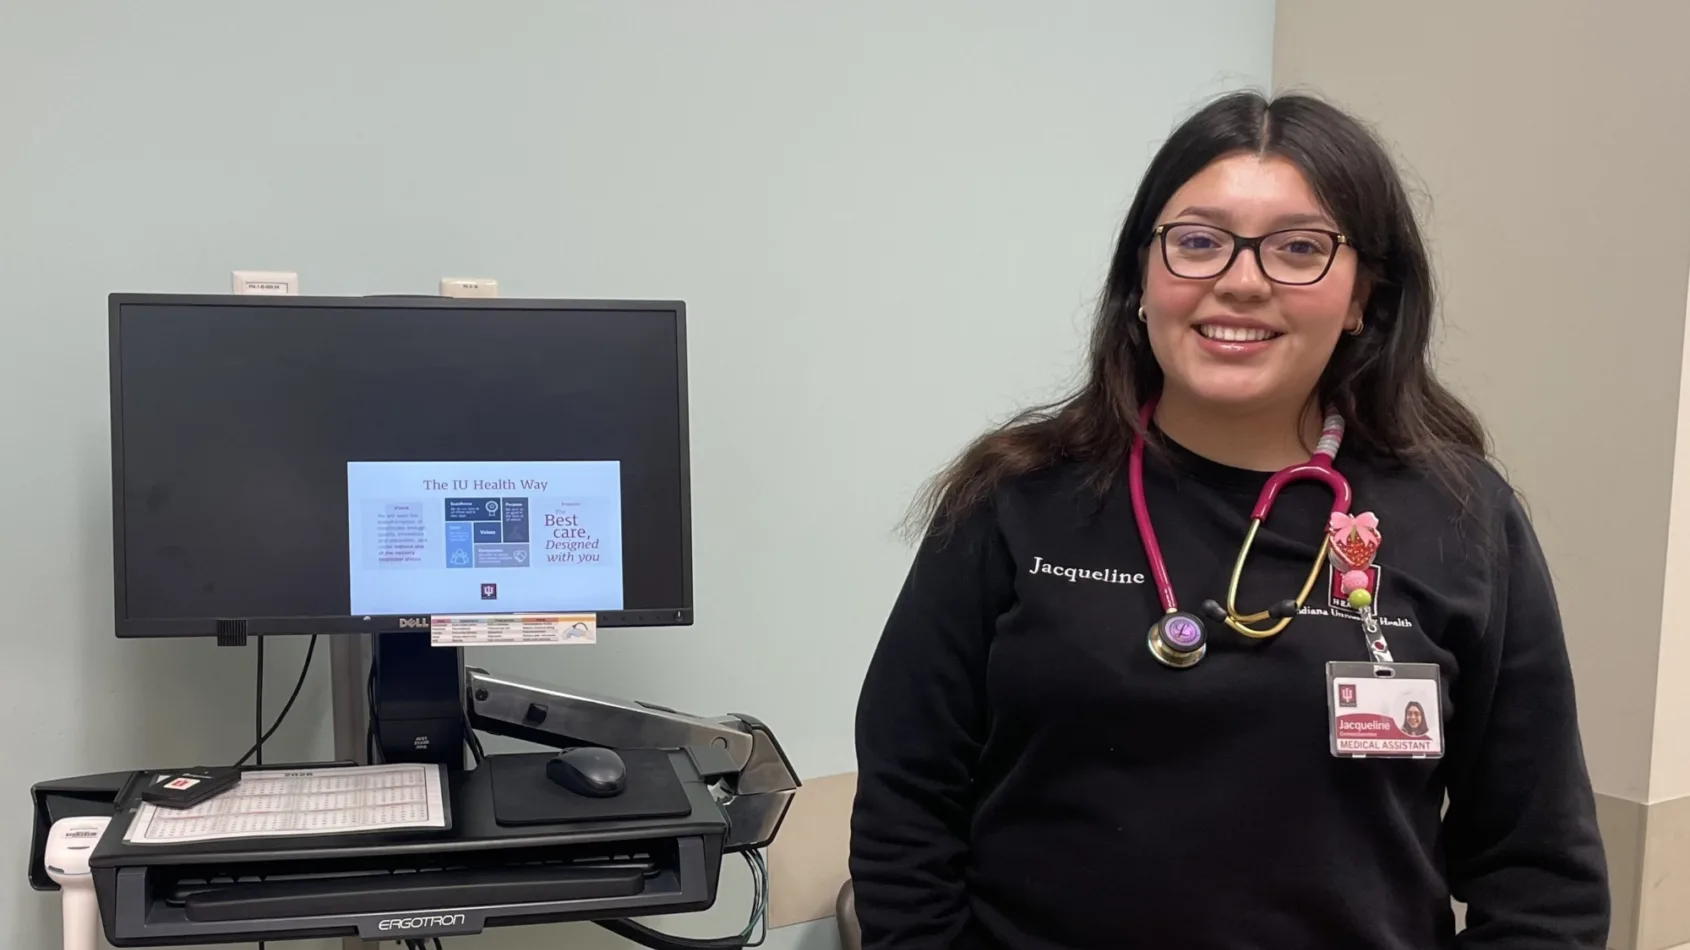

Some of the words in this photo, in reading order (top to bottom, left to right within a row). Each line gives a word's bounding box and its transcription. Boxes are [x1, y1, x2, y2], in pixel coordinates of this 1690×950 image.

[423, 479, 448, 490] The
[452, 479, 468, 490] IU
[473, 479, 516, 490] Health
[520, 479, 548, 491] Way
[544, 513, 579, 527] Best
[553, 527, 591, 540] care,
[545, 538, 600, 551] Designed
[546, 551, 574, 562] with
[576, 553, 600, 564] you
[1029, 556, 1145, 584] Jacqueline
[399, 617, 430, 628] DELL
[1380, 617, 1412, 627] Health
[1339, 719, 1391, 731] Jacqueline
[1340, 740, 1380, 749] MEDICAL
[1382, 741, 1430, 749] ASSISTANT
[378, 913, 466, 931] ERGOTRON
